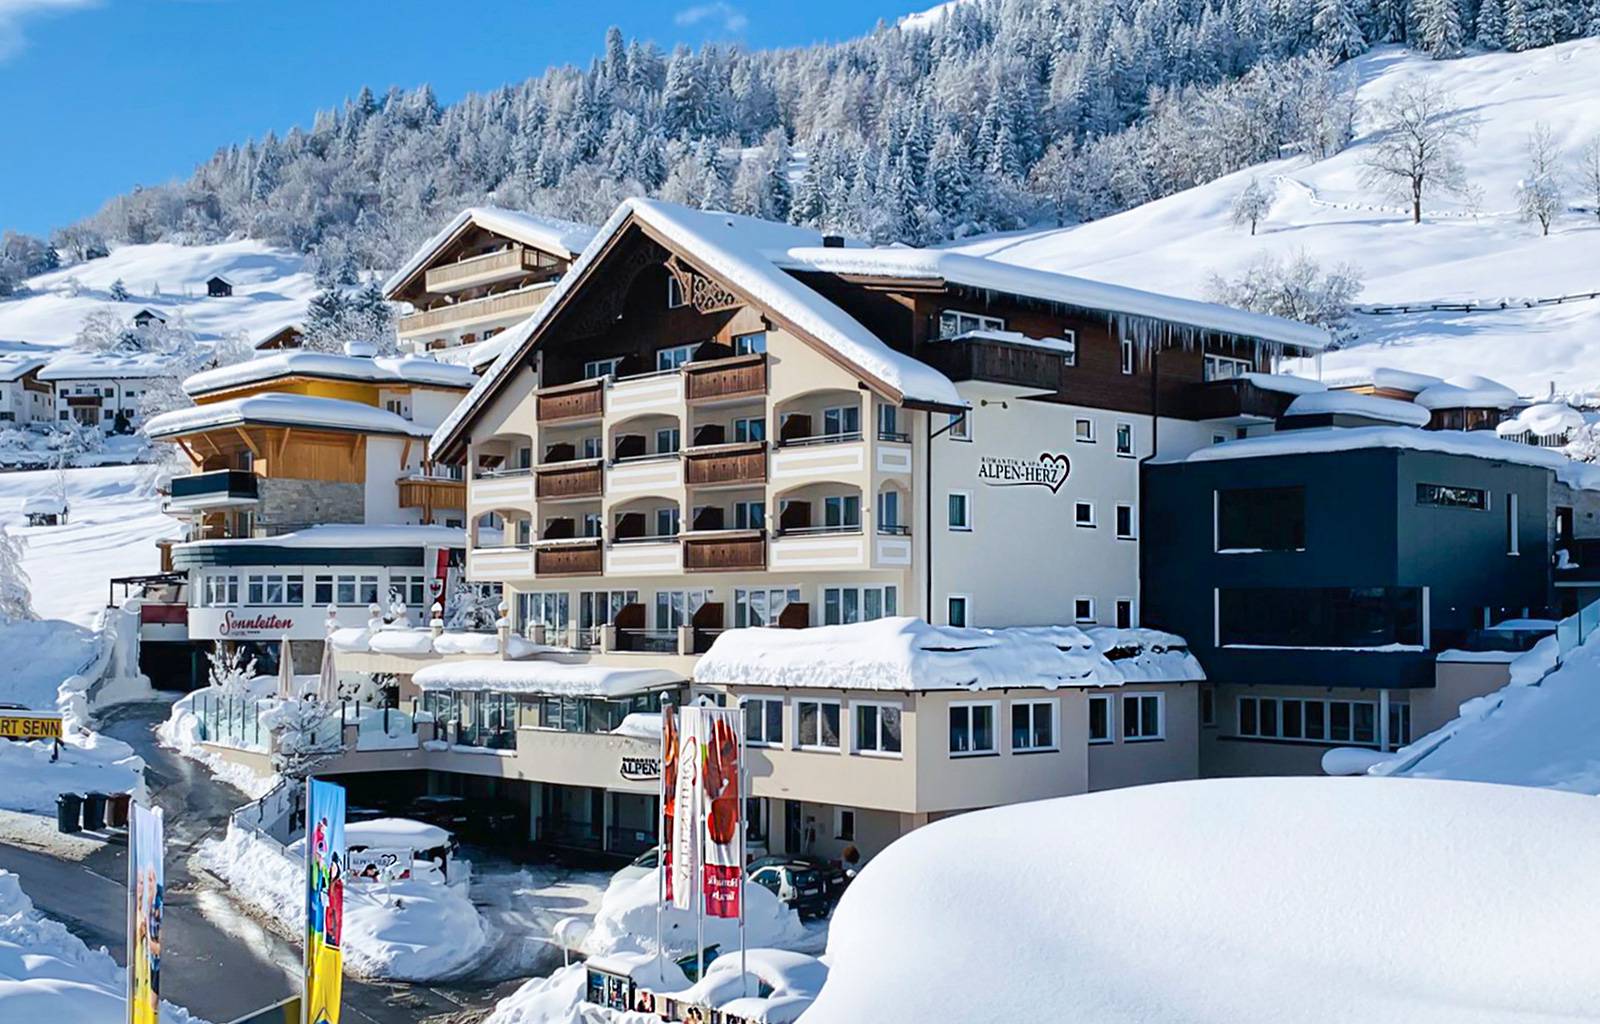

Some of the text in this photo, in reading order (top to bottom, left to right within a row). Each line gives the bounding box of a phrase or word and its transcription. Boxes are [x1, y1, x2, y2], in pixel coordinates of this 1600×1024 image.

[978, 463, 1059, 483] ALPEN-HERZ
[219, 609, 294, 636] Sonnleiten
[22, 719, 60, 736] SENN
